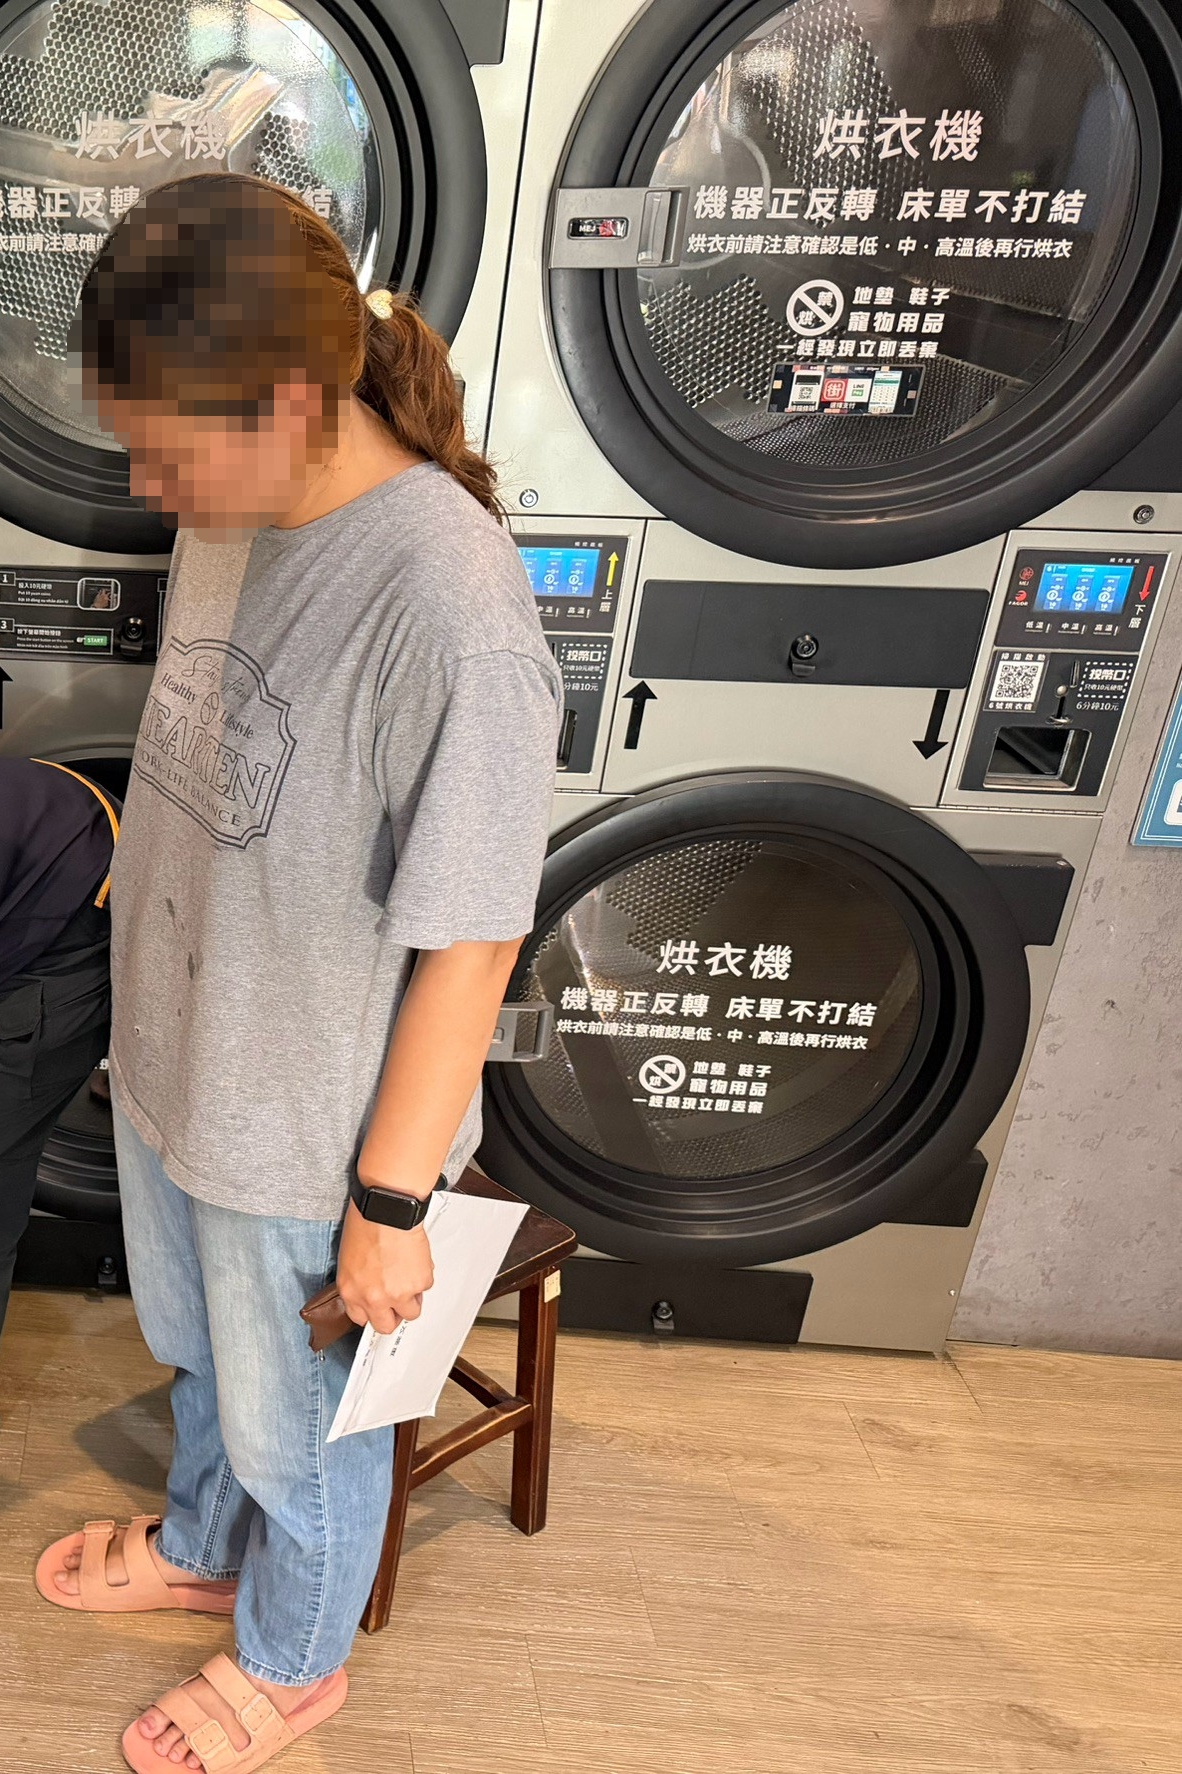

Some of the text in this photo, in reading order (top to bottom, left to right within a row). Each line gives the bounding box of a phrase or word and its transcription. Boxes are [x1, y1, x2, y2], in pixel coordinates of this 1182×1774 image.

[75, 110, 227, 161] 烘衣機
[813, 109, 983, 163] 烘衣機
[693, 185, 1087, 224] 機器正反轉 床單不打結
[852, 286, 951, 306] 地墊 鞋子
[847, 311, 946, 334] 寵物用品
[776, 339, 940, 358] 一經發現立即丟棄
[2, 574, 8, 583] 1
[1, 620, 7, 629] 3
[567, 650, 602, 662] 投幣口
[1088, 668, 1127, 681] 投幣口
[563, 682, 599, 691] 分鐘10元
[160, 673, 198, 705] Healthy
[219, 709, 254, 740] Lifestyle
[1076, 702, 1119, 711] 6分鐘10元
[190, 785, 241, 827] BALANCE
[656, 939, 794, 981] 烘衣機
[560, 986, 878, 1027] 機器正反轉 床單不打結
[692, 1060, 772, 1078] 地墊 鞋子
[689, 1078, 768, 1097] 寵物用品
